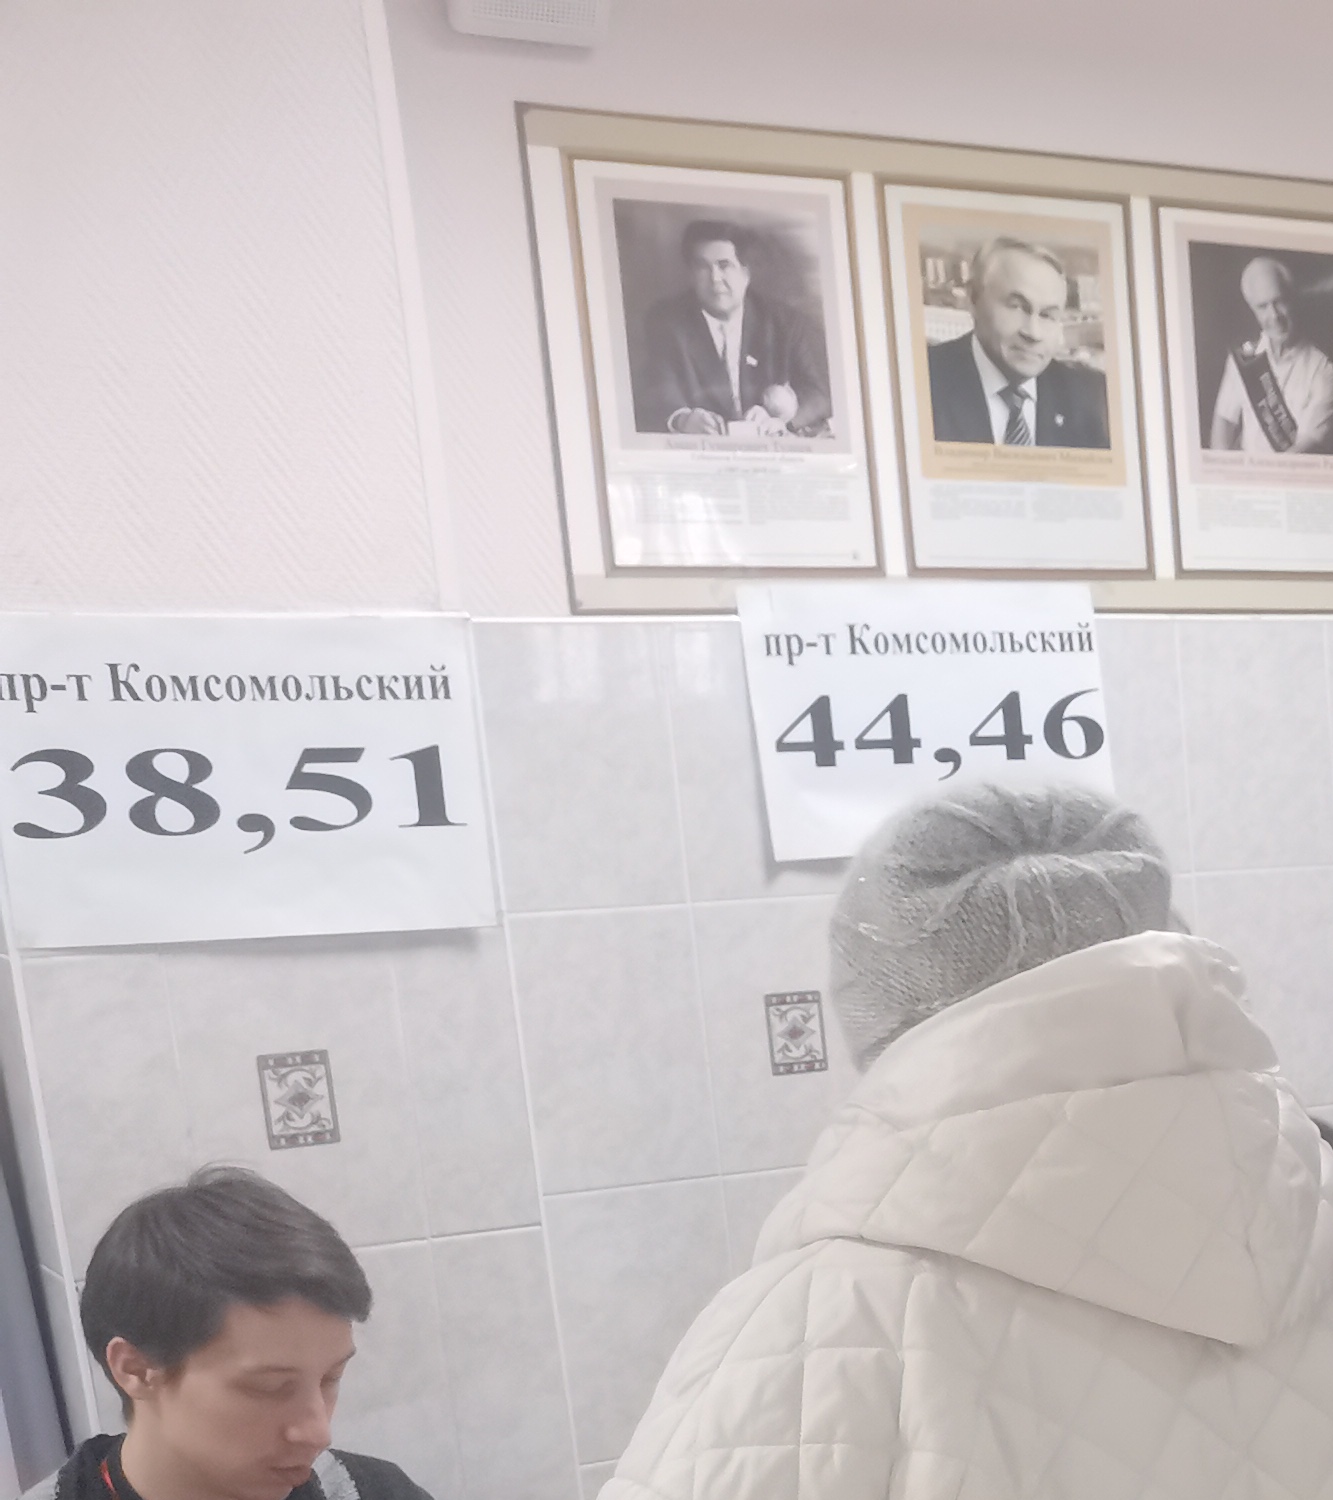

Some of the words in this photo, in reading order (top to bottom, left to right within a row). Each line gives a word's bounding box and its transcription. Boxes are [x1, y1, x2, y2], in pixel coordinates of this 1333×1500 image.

[764, 632, 836, 666] пр-т
[846, 622, 1096, 656] Комсомольский
[0, 673, 93, 714] пр-т
[104, 662, 453, 702] Комсомольский
[775, 687, 1105, 781] 44,46
[9, 744, 468, 855] 38,51
